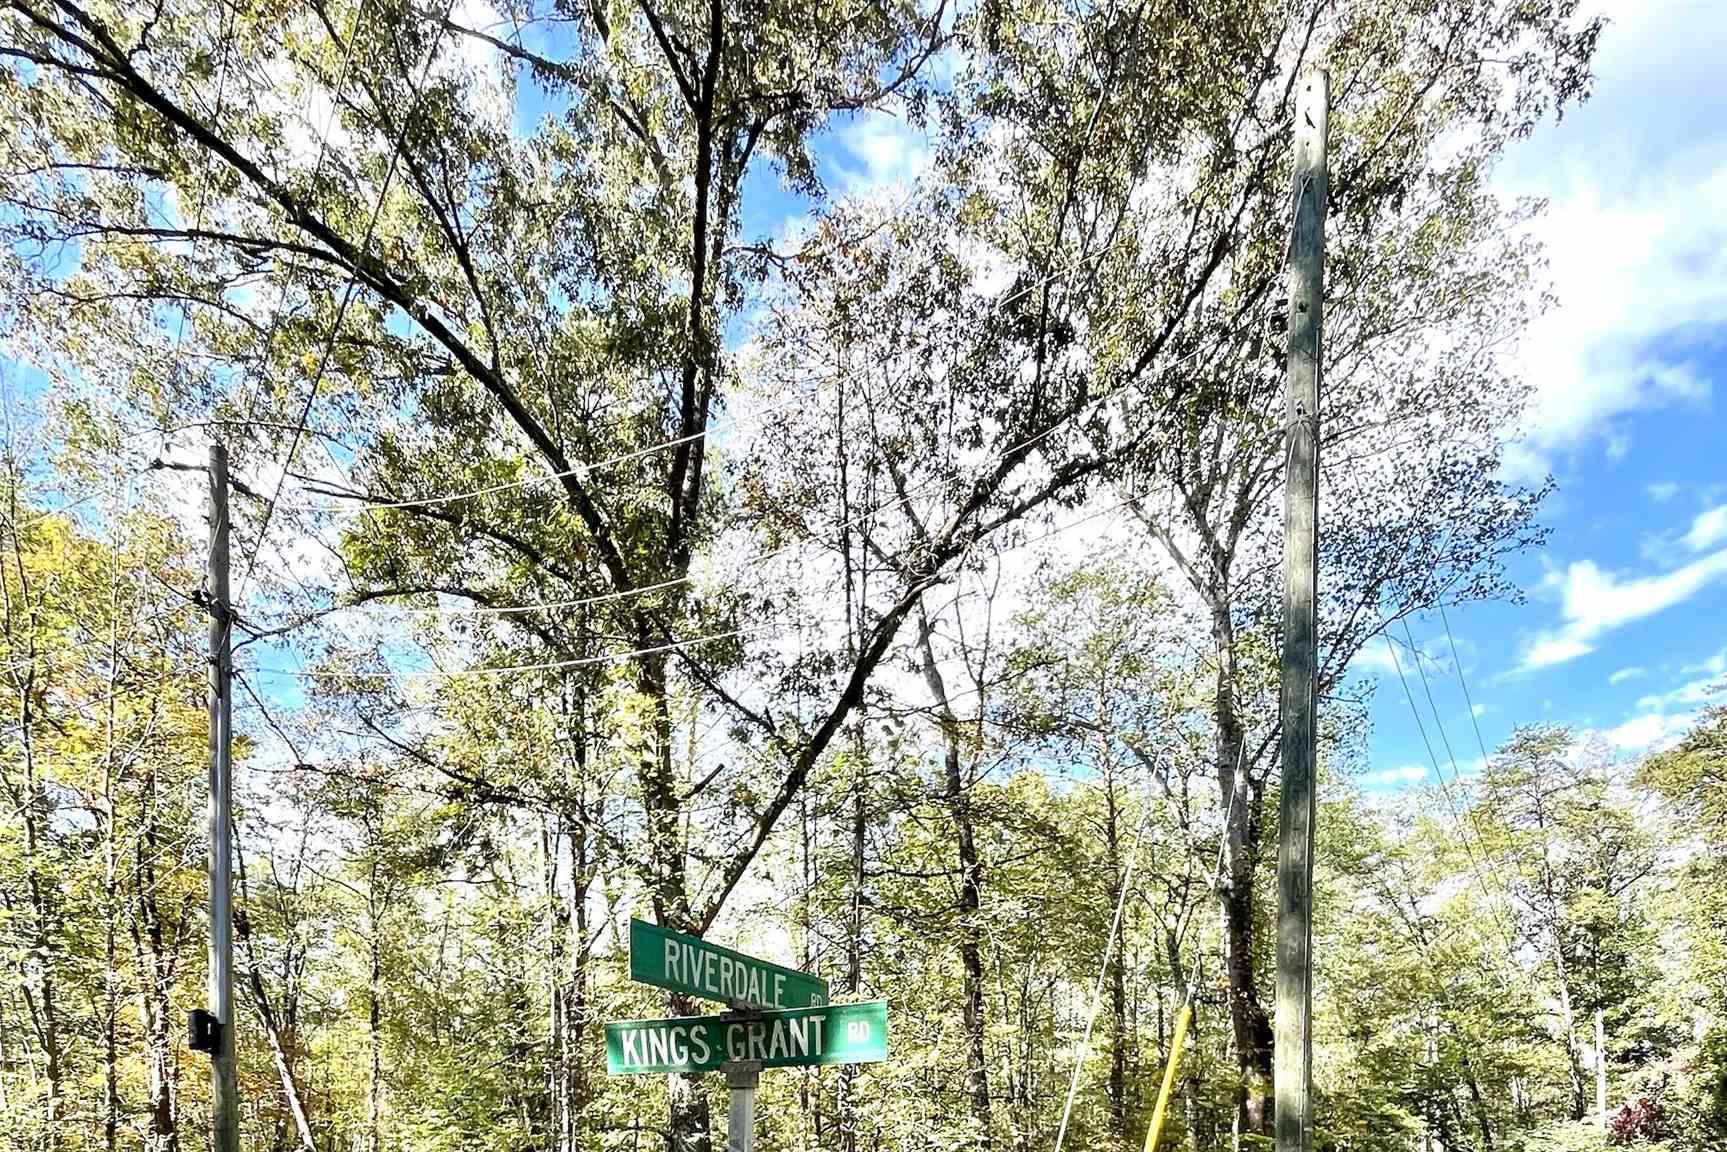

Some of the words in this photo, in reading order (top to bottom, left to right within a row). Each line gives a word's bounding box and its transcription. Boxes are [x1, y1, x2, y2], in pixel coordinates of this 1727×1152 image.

[664, 938, 786, 1009] RIVERDALE
[811, 992, 823, 1007] RD
[621, 1024, 711, 1066] KINGS
[726, 1015, 826, 1062] GRANT
[847, 1021, 870, 1042] RD
